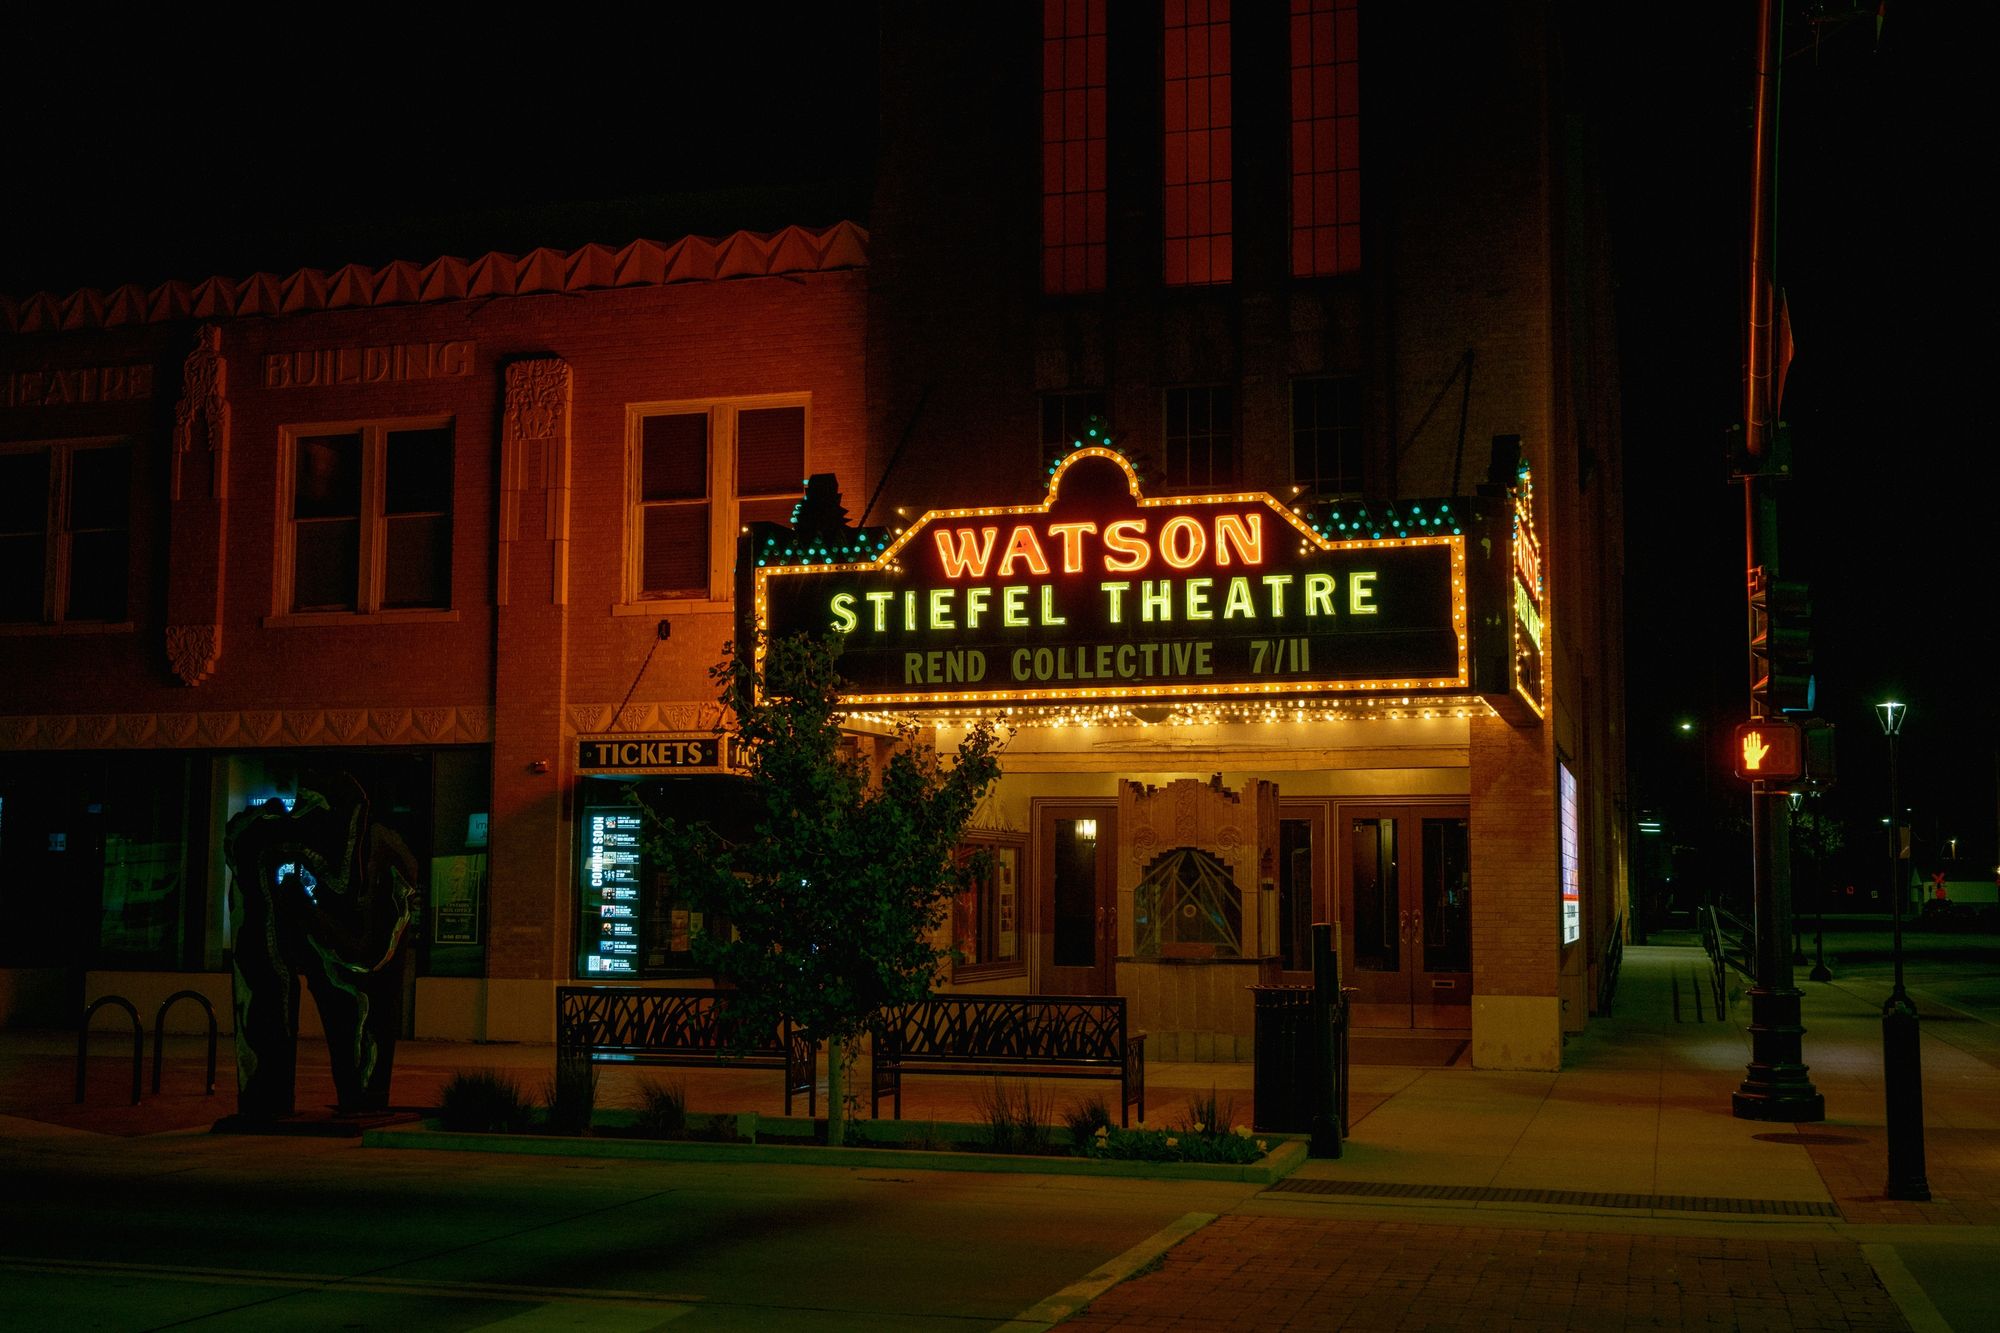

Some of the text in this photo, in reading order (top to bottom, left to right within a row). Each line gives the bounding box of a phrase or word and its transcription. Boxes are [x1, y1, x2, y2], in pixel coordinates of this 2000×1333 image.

[264, 341, 472, 387] BUILDING
[933, 513, 1262, 578] WATSON
[830, 571, 1378, 634] STIEFEL THEATRE
[905, 638, 1310, 684] REND COLLECTIVE 7/11
[595, 742, 703, 765] TICKETS
[592, 816, 605, 886] COMING SOON
